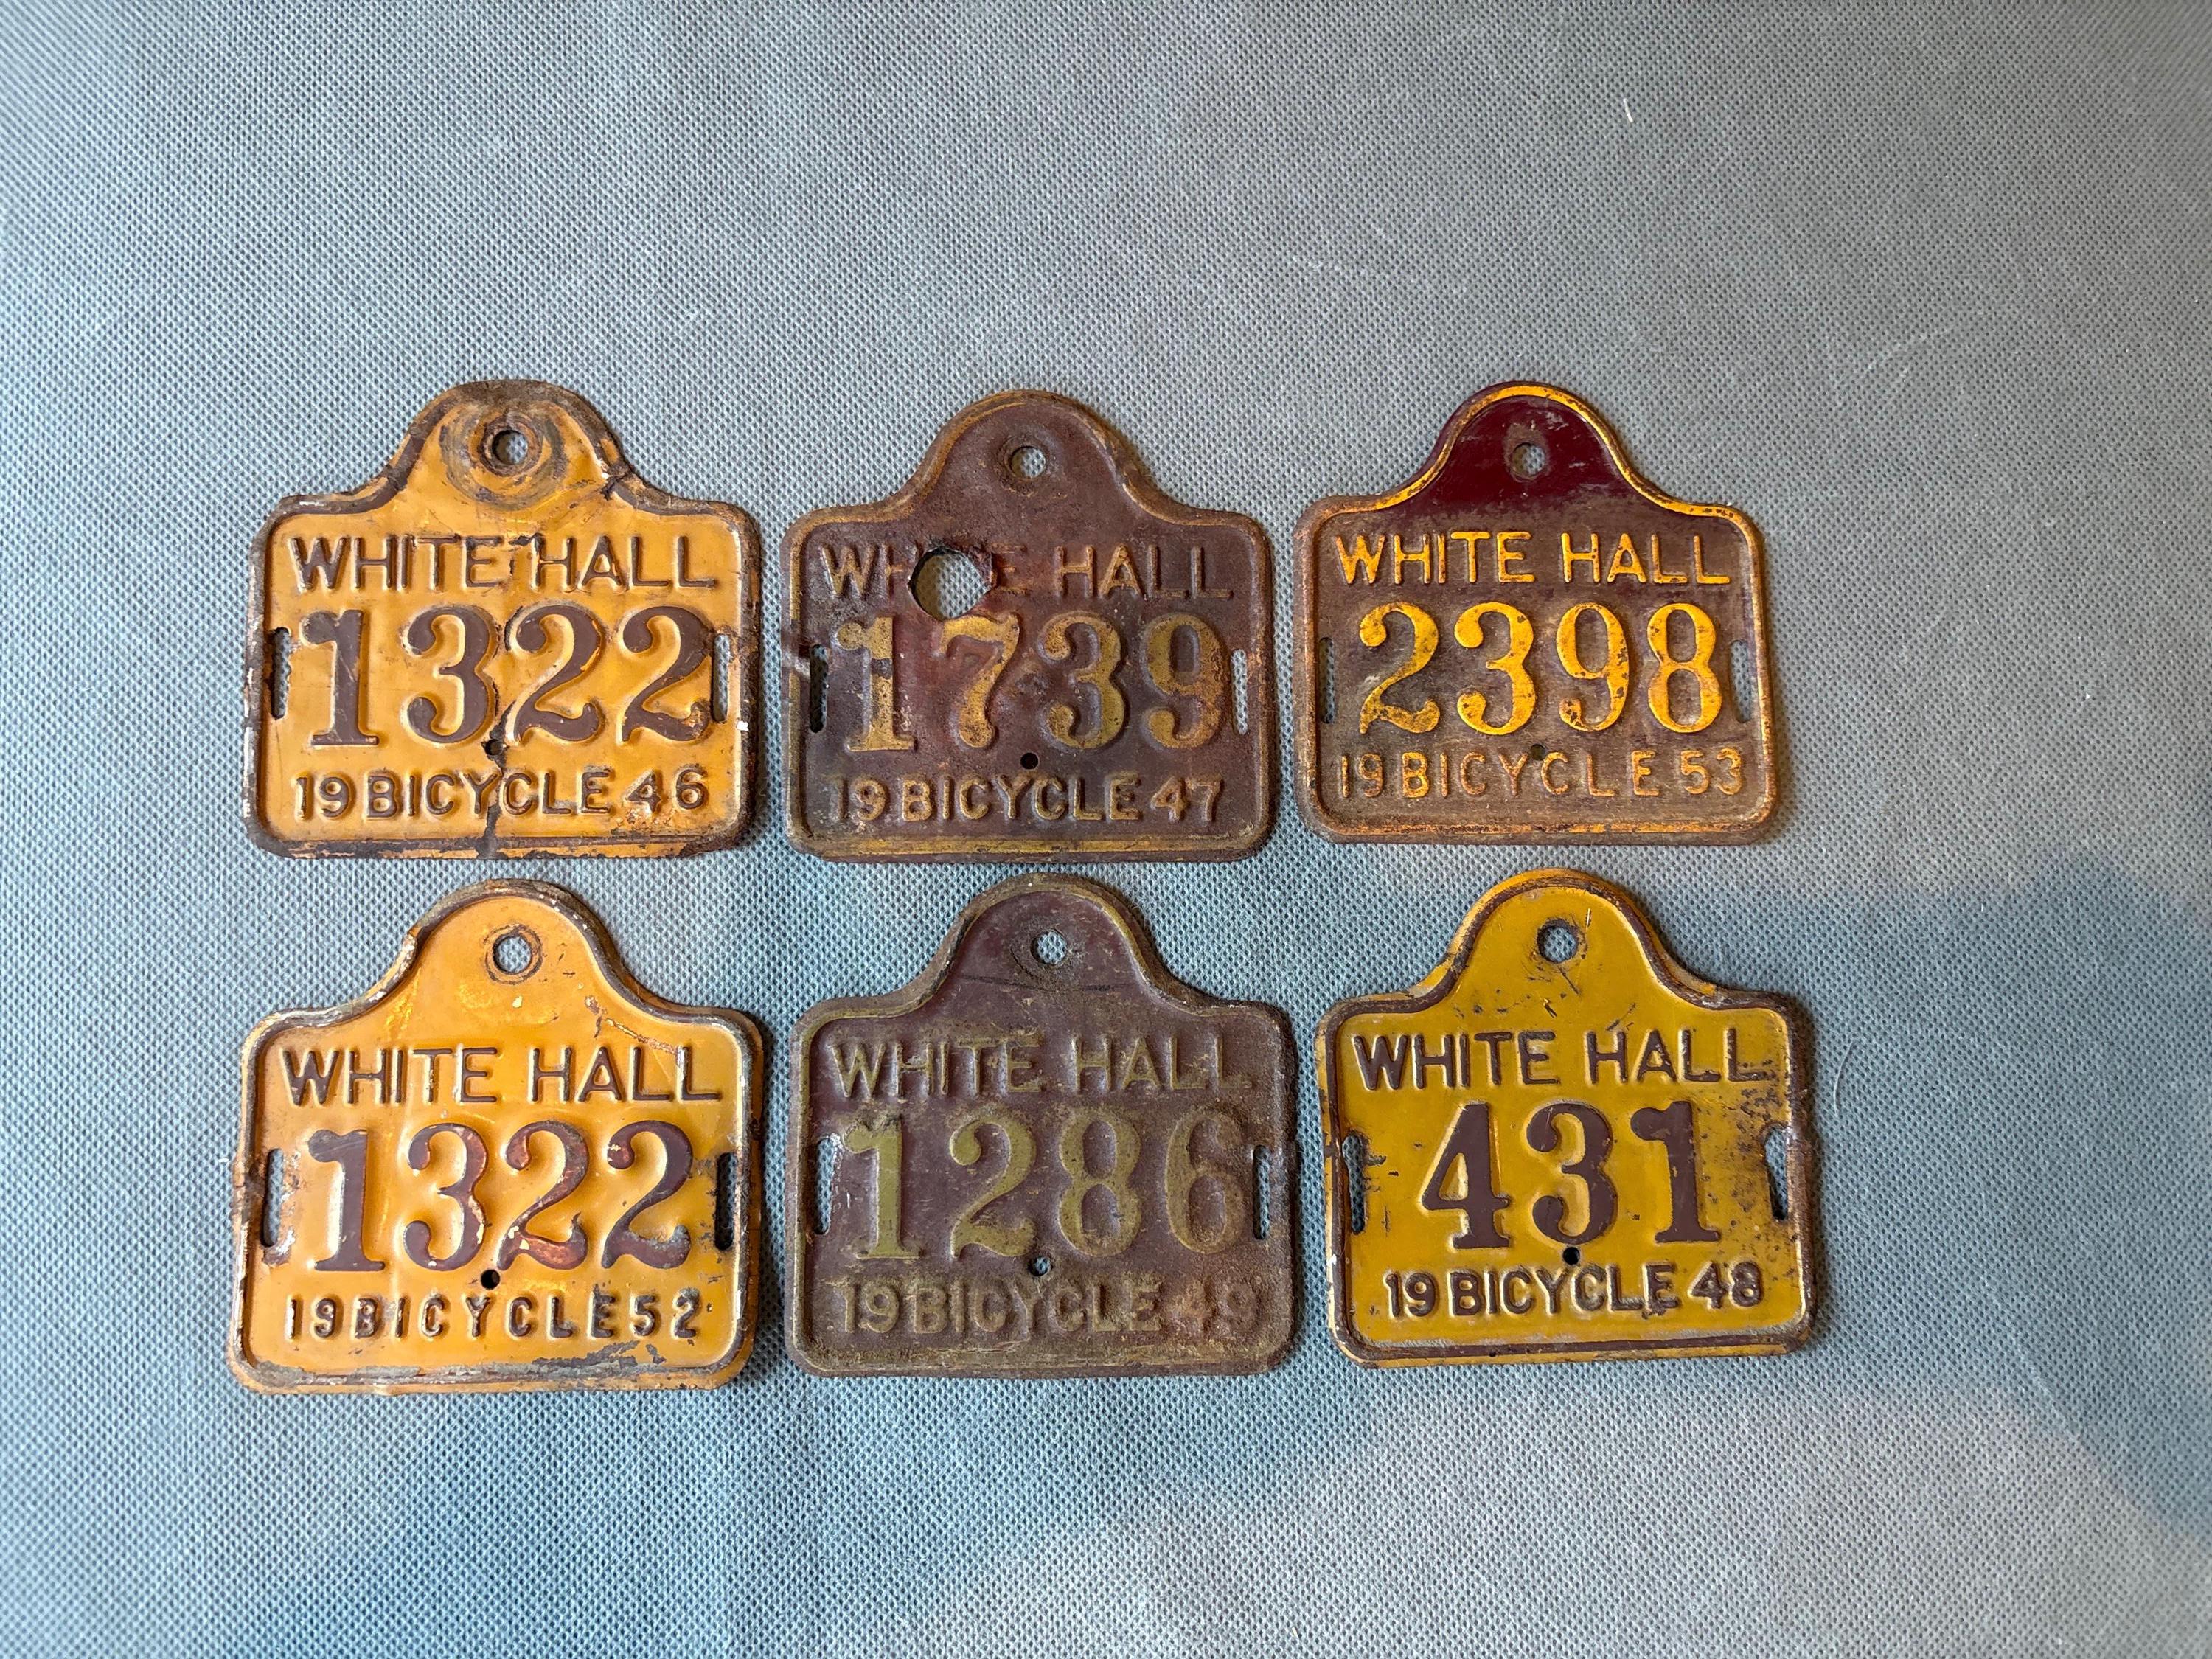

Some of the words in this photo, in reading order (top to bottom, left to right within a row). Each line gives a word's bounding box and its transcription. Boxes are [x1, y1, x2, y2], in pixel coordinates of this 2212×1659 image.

[288, 534, 503, 591] WHITE
[525, 534, 719, 590] HALL
[821, 541, 1031, 598] WHE
[1054, 543, 1234, 600] HALL
[1335, 531, 1536, 585] WHITE
[1560, 532, 1731, 585] HALL
[301, 605, 715, 747] 1322
[836, 613, 1230, 752] 1739
[1358, 601, 1722, 737] 2398
[296, 774, 355, 818] 19
[364, 771, 611, 821] BICYCLE
[622, 767, 710, 815] 46
[825, 774, 886, 823] 19
[901, 774, 1141, 821] BICYCLE
[1150, 776, 1225, 822] 47
[1340, 751, 1385, 800] 19
[1400, 749, 1662, 799] BICYCLE
[1676, 748, 1744, 796] 53
[282, 1046, 498, 1106] WHITE
[529, 1046, 723, 1102] HALL
[830, 1035, 1040, 1099] WHITE
[1069, 1033, 1251, 1095] HALL
[1354, 1030, 1559, 1091] WHITE
[1586, 1029, 1771, 1085] HALL
[307, 1120, 695, 1273] 1322
[844, 1111, 1245, 1260] 1286
[1420, 1102, 1721, 1249] 431
[832, 1277, 900, 1333] 19
[909, 1276, 1162, 1335] BICYCLE
[1383, 1273, 1440, 1318] 19
[1450, 1264, 1680, 1317] BICYCLE
[1688, 1260, 1764, 1309] 48
